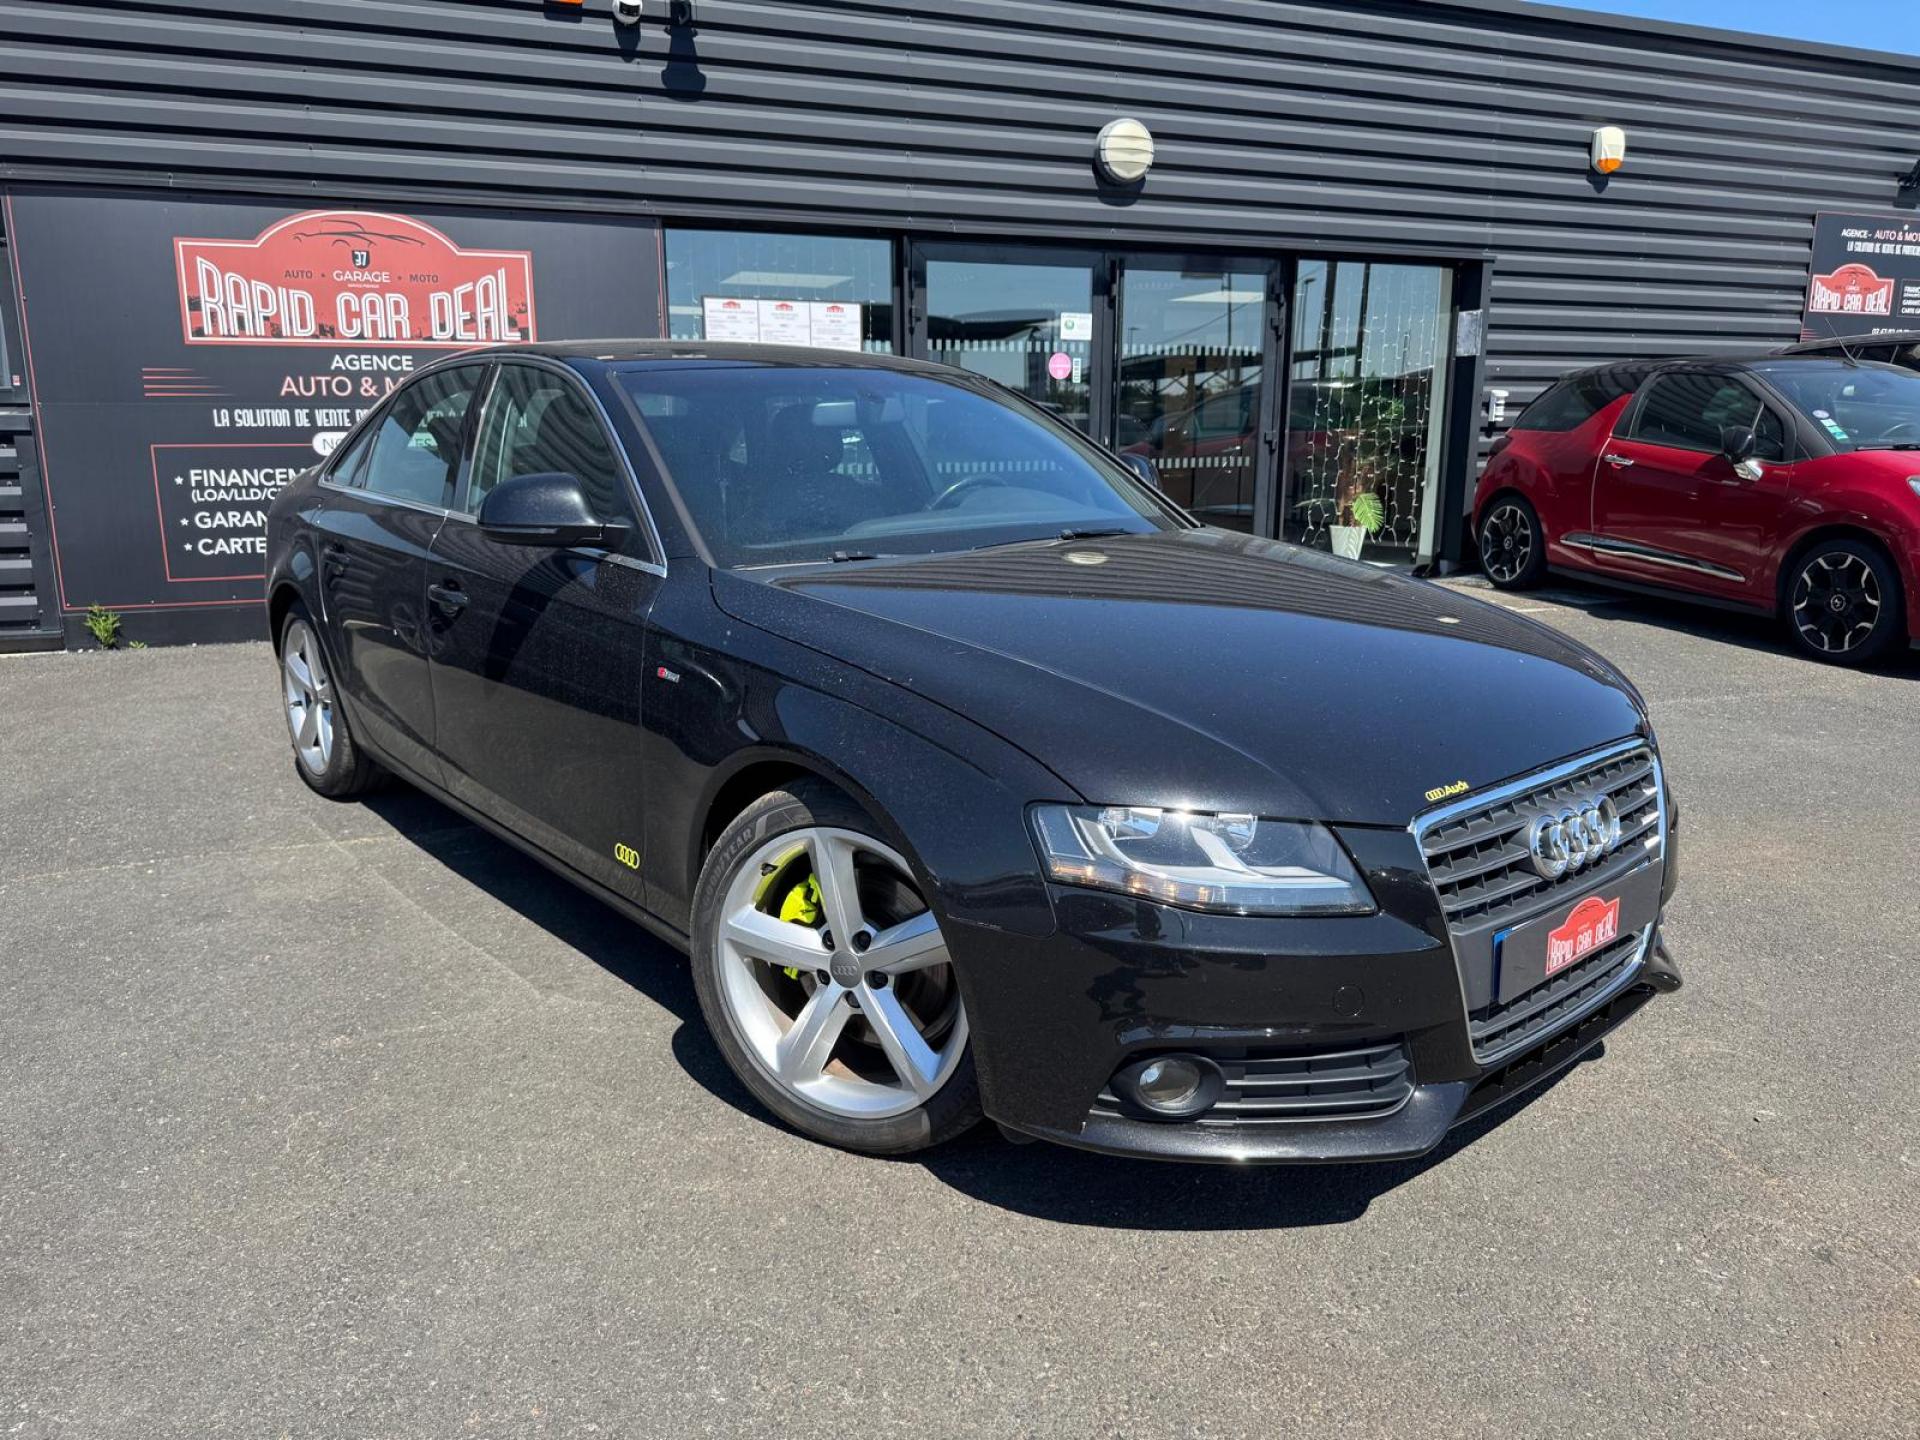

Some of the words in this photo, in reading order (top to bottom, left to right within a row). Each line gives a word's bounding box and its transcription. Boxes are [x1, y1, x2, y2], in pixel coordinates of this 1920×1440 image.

[1874, 230, 1897, 241] AUTO
[353, 251, 368, 267] 37
[284, 270, 313, 280] AUTO
[332, 270, 392, 283] GARAGE
[409, 273, 439, 284] MOTO
[196, 256, 316, 337] RAPID
[336, 293, 411, 339] CAR
[429, 267, 522, 342] DEAL
[1813, 280, 1841, 311] RAPID
[1843, 293, 1862, 312] CAR
[1865, 283, 1888, 313] DEAL
[331, 354, 414, 371] AGENCE
[280, 376, 353, 397] AUTO
[360, 376, 380, 397] &
[213, 408, 230, 427] LA
[234, 408, 291, 428] SOLUTION
[295, 408, 311, 427] DE
[315, 408, 352, 427] VENTE
[197, 537, 268, 556] CARTE
[1444, 780, 1469, 796] Audi
[1576, 929, 1593, 954] CAR
